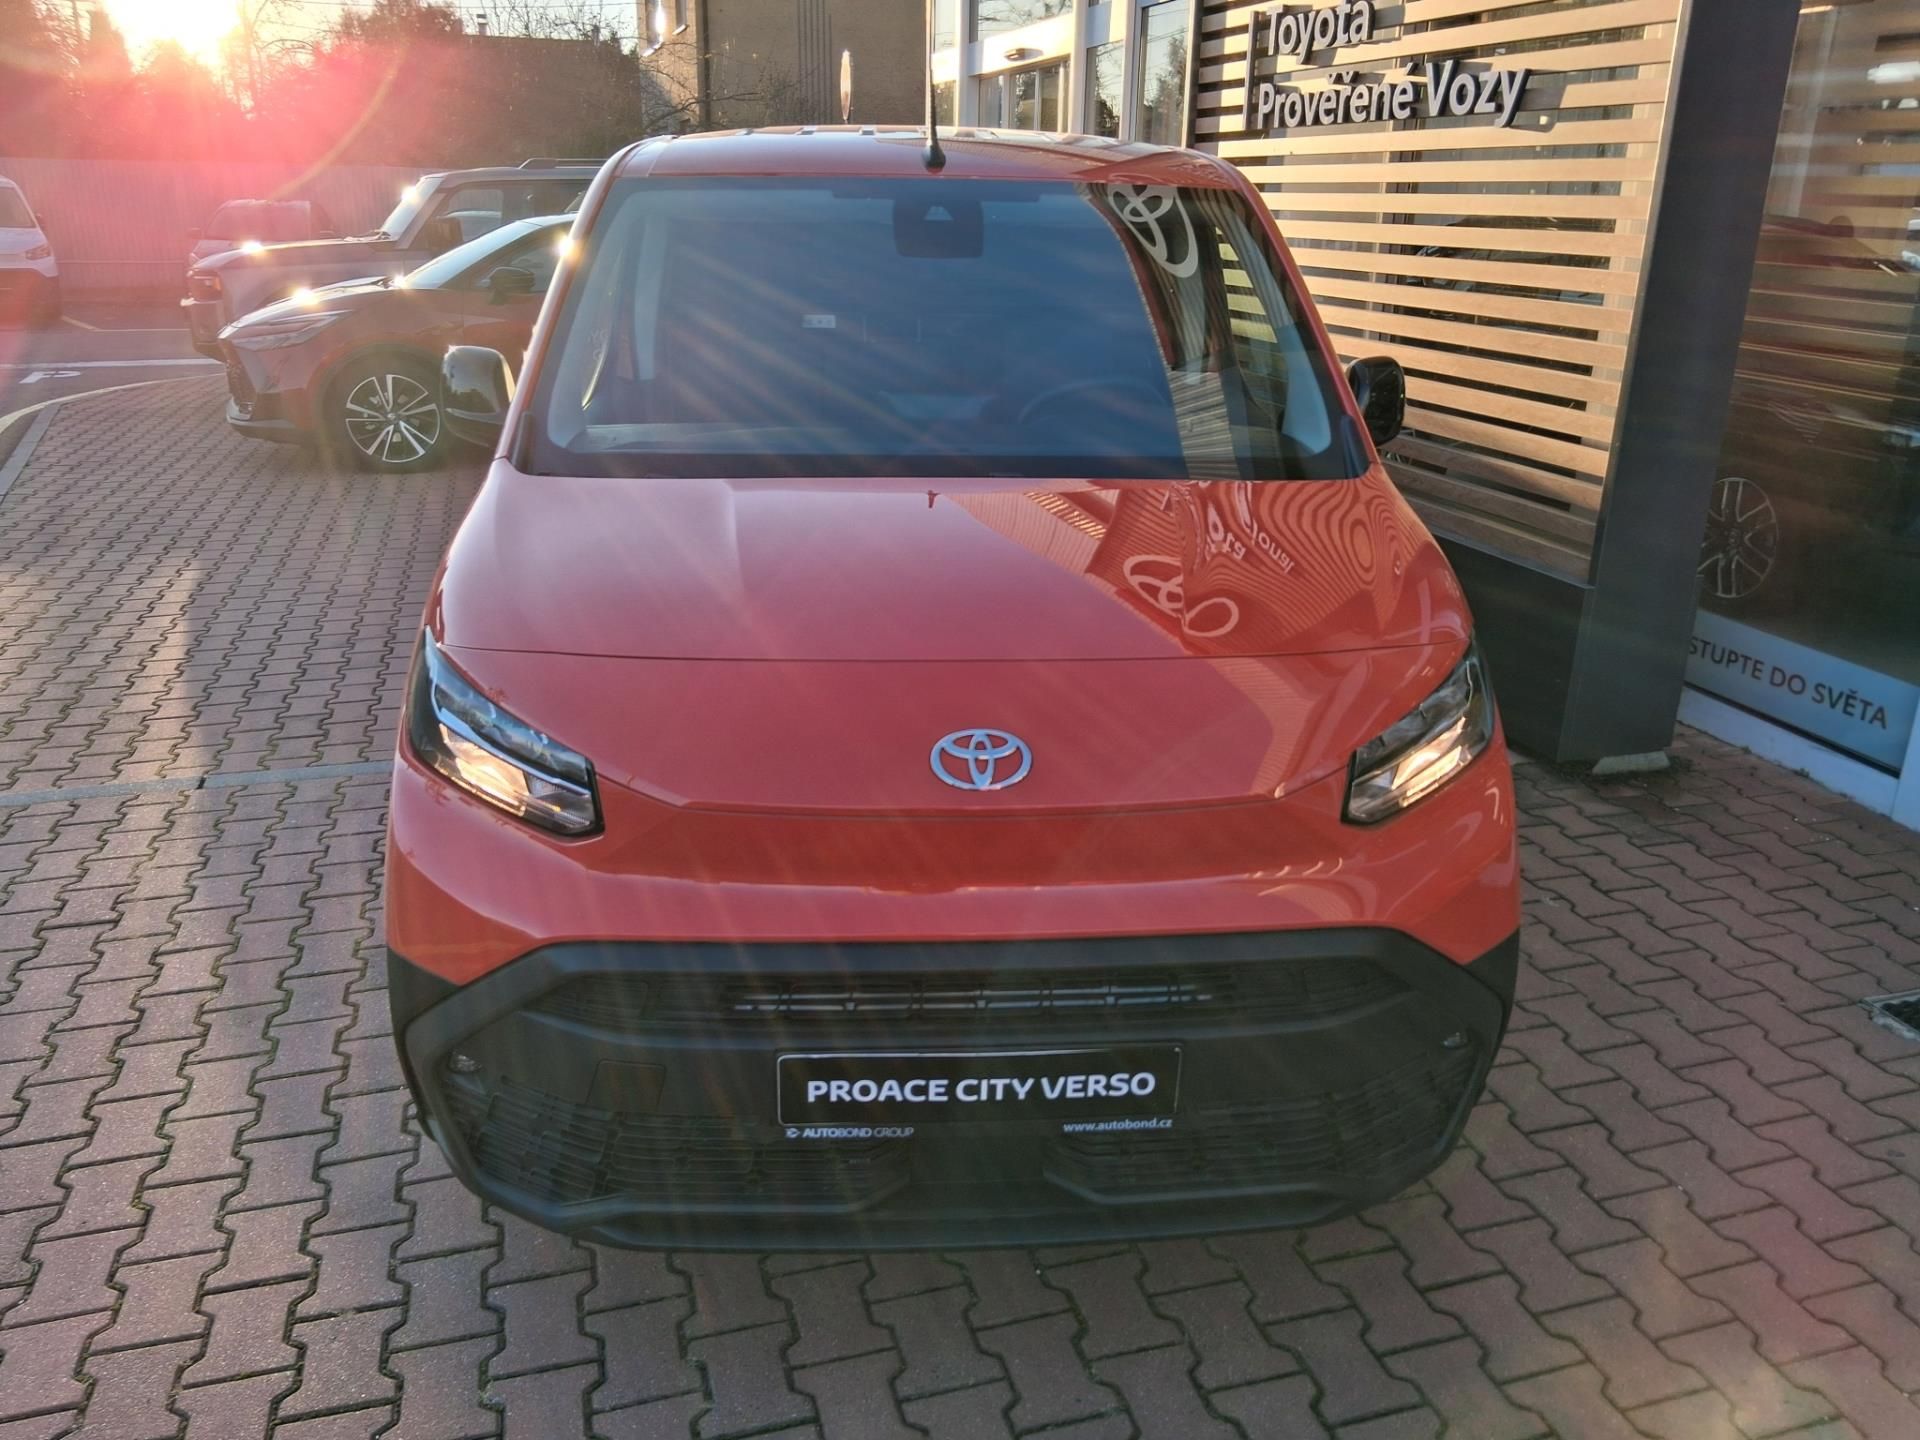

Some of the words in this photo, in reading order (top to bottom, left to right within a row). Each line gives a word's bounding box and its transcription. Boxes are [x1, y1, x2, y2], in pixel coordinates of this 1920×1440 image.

[1266, 0, 1374, 64] Toyota
[1257, 62, 1417, 130] Prověřené
[1426, 60, 1530, 128] Vozy
[1769, 666, 1806, 695] DO
[1811, 682, 1887, 730] SVĚTA
[807, 1079, 949, 1103] PROACE
[955, 1077, 1035, 1102] CITY
[1040, 1072, 1156, 1100] VERSO
[802, 1127, 872, 1138] AUTOBOND
[873, 1127, 915, 1137] GROUP
[1062, 1117, 1173, 1133] www.autobond.cz
